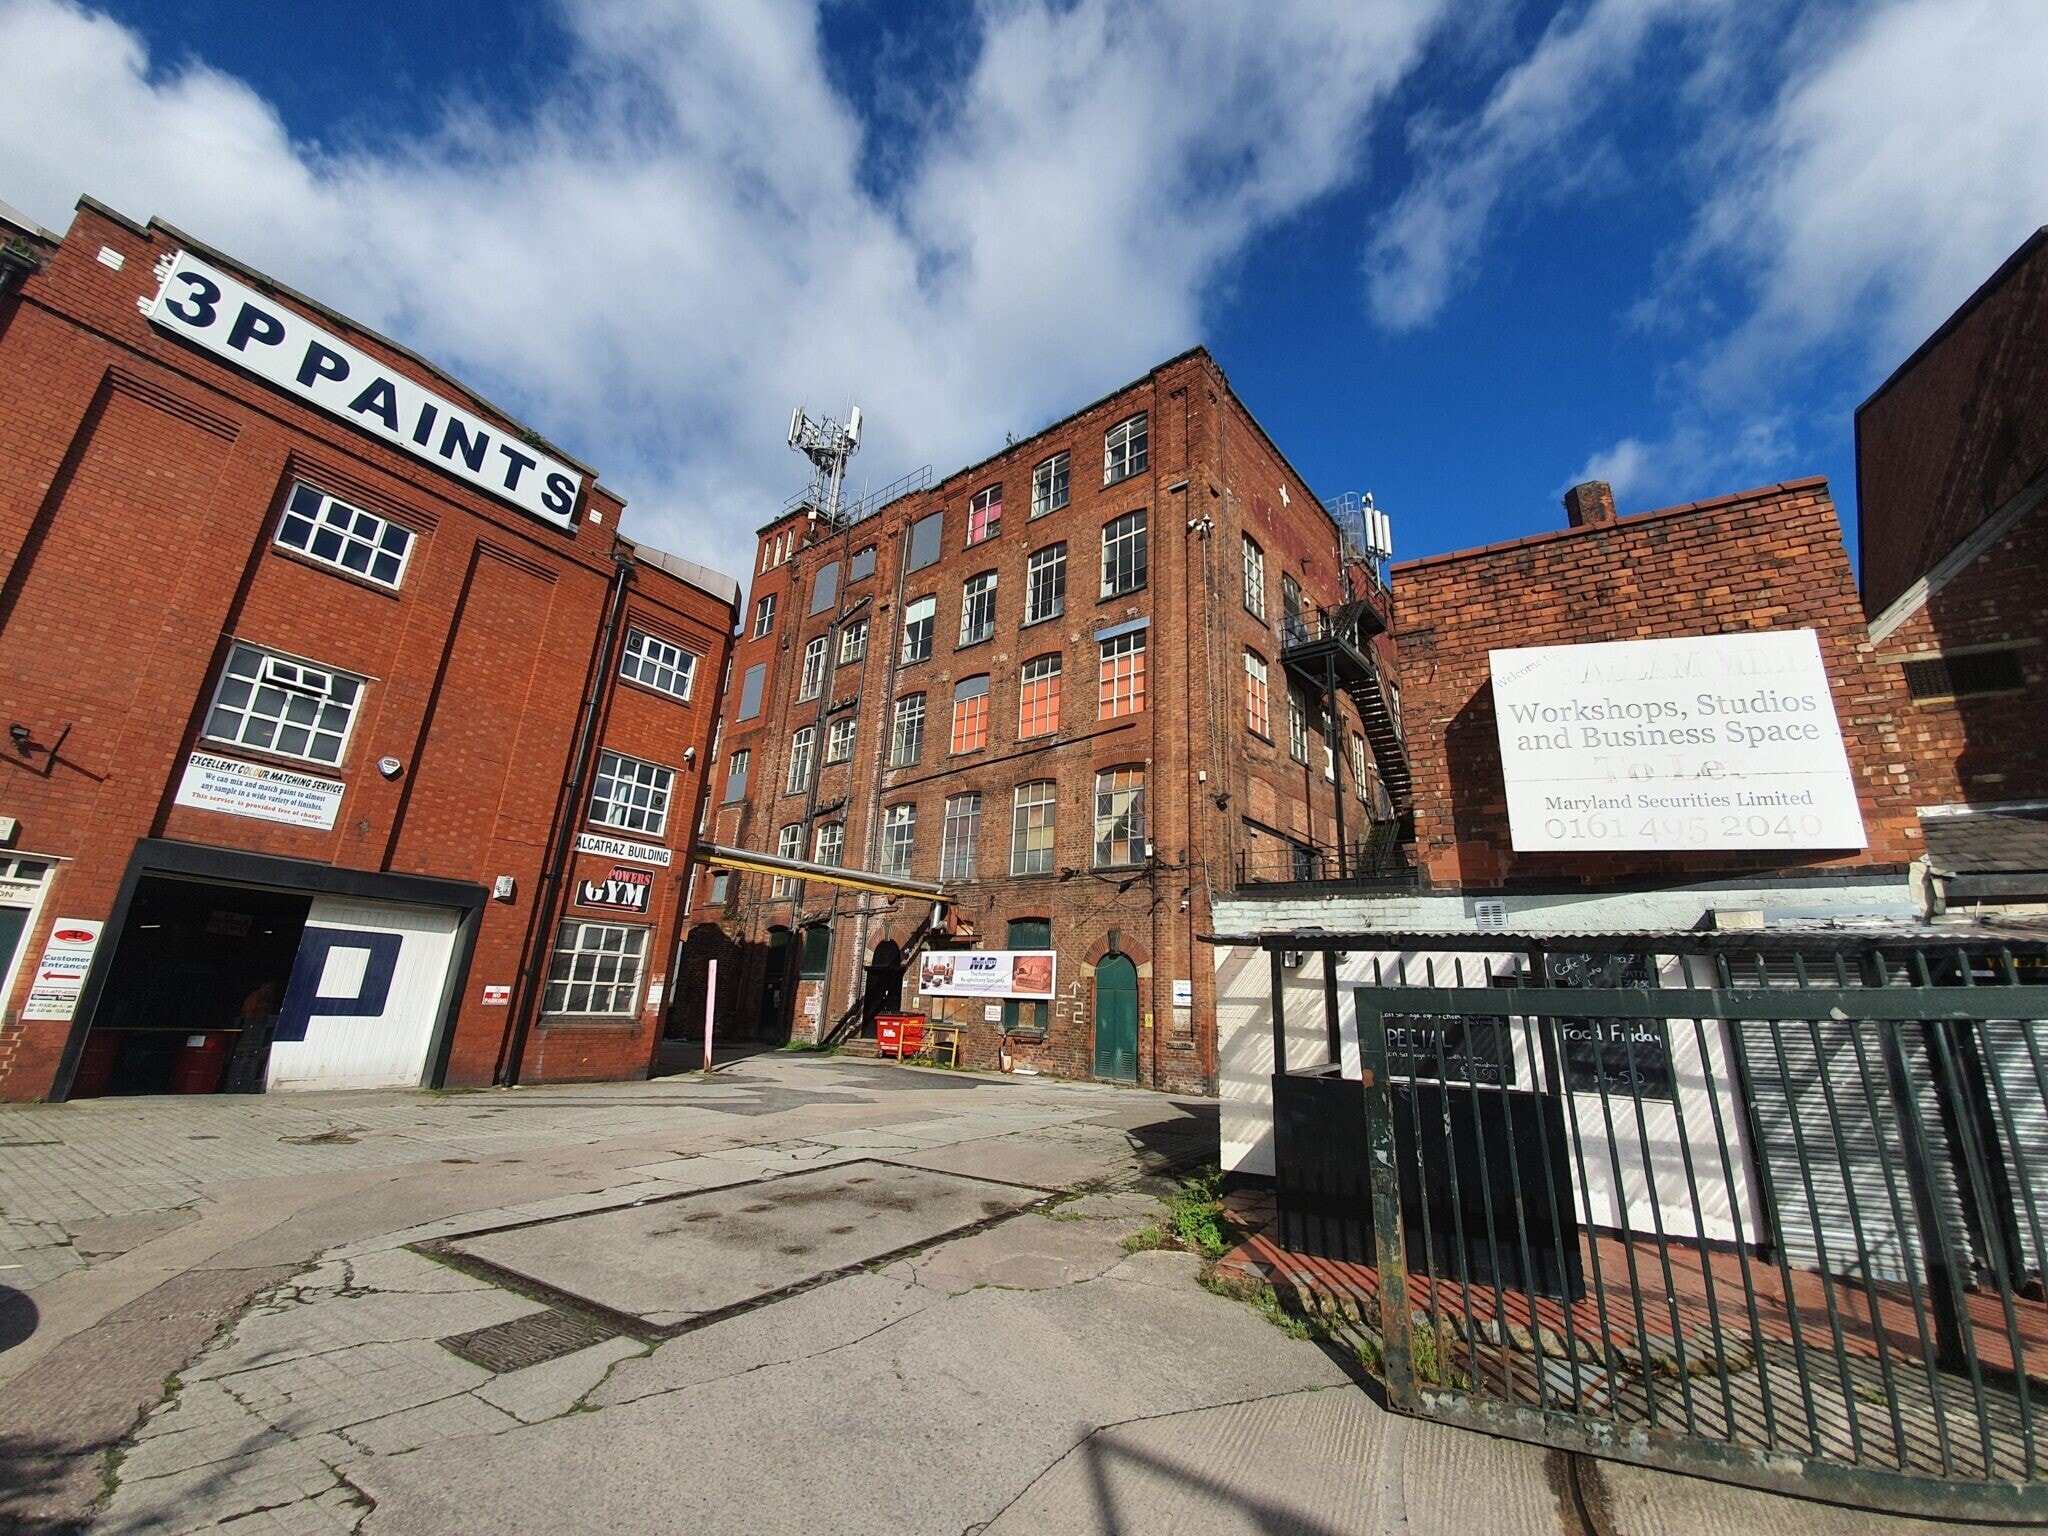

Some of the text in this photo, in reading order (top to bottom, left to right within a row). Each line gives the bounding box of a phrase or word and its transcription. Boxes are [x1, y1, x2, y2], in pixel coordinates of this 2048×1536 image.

[296, 340, 576, 516] PAINTS
[1495, 657, 1544, 689] Welcome
[1508, 690, 1817, 725] Workshops, Studios
[1517, 720, 1821, 752] and Business Space
[190, 755, 344, 794] EXCELLENT COLOUR MATCHING SERVICE
[1593, 755, 1654, 784] To
[200, 782, 213, 792] any
[214, 785, 237, 798] sample
[237, 787, 245, 796] in
[251, 791, 267, 801] wide
[268, 794, 290, 806] variety
[290, 798, 298, 807] of
[205, 772, 327, 803] We can mix and match paint to almost
[1544, 789, 1814, 813] Maryland Securities Limited
[192, 791, 208, 800] This
[209, 794, 235, 805] service
[245, 801, 276, 812] provided
[277, 806, 292, 815] free
[292, 808, 300, 816] of
[1544, 811, 1824, 844] 0161 495 2040
[575, 836, 669, 863] ALCATRAZ BUILDING
[607, 869, 651, 886] POWERS
[585, 879, 646, 907] GYM
[41, 961, 88, 970] Entrance
[44, 954, 90, 963] Customer
[1386, 1028, 1453, 1048] PECIAL
[1610, 1023, 1663, 1049] Friday
